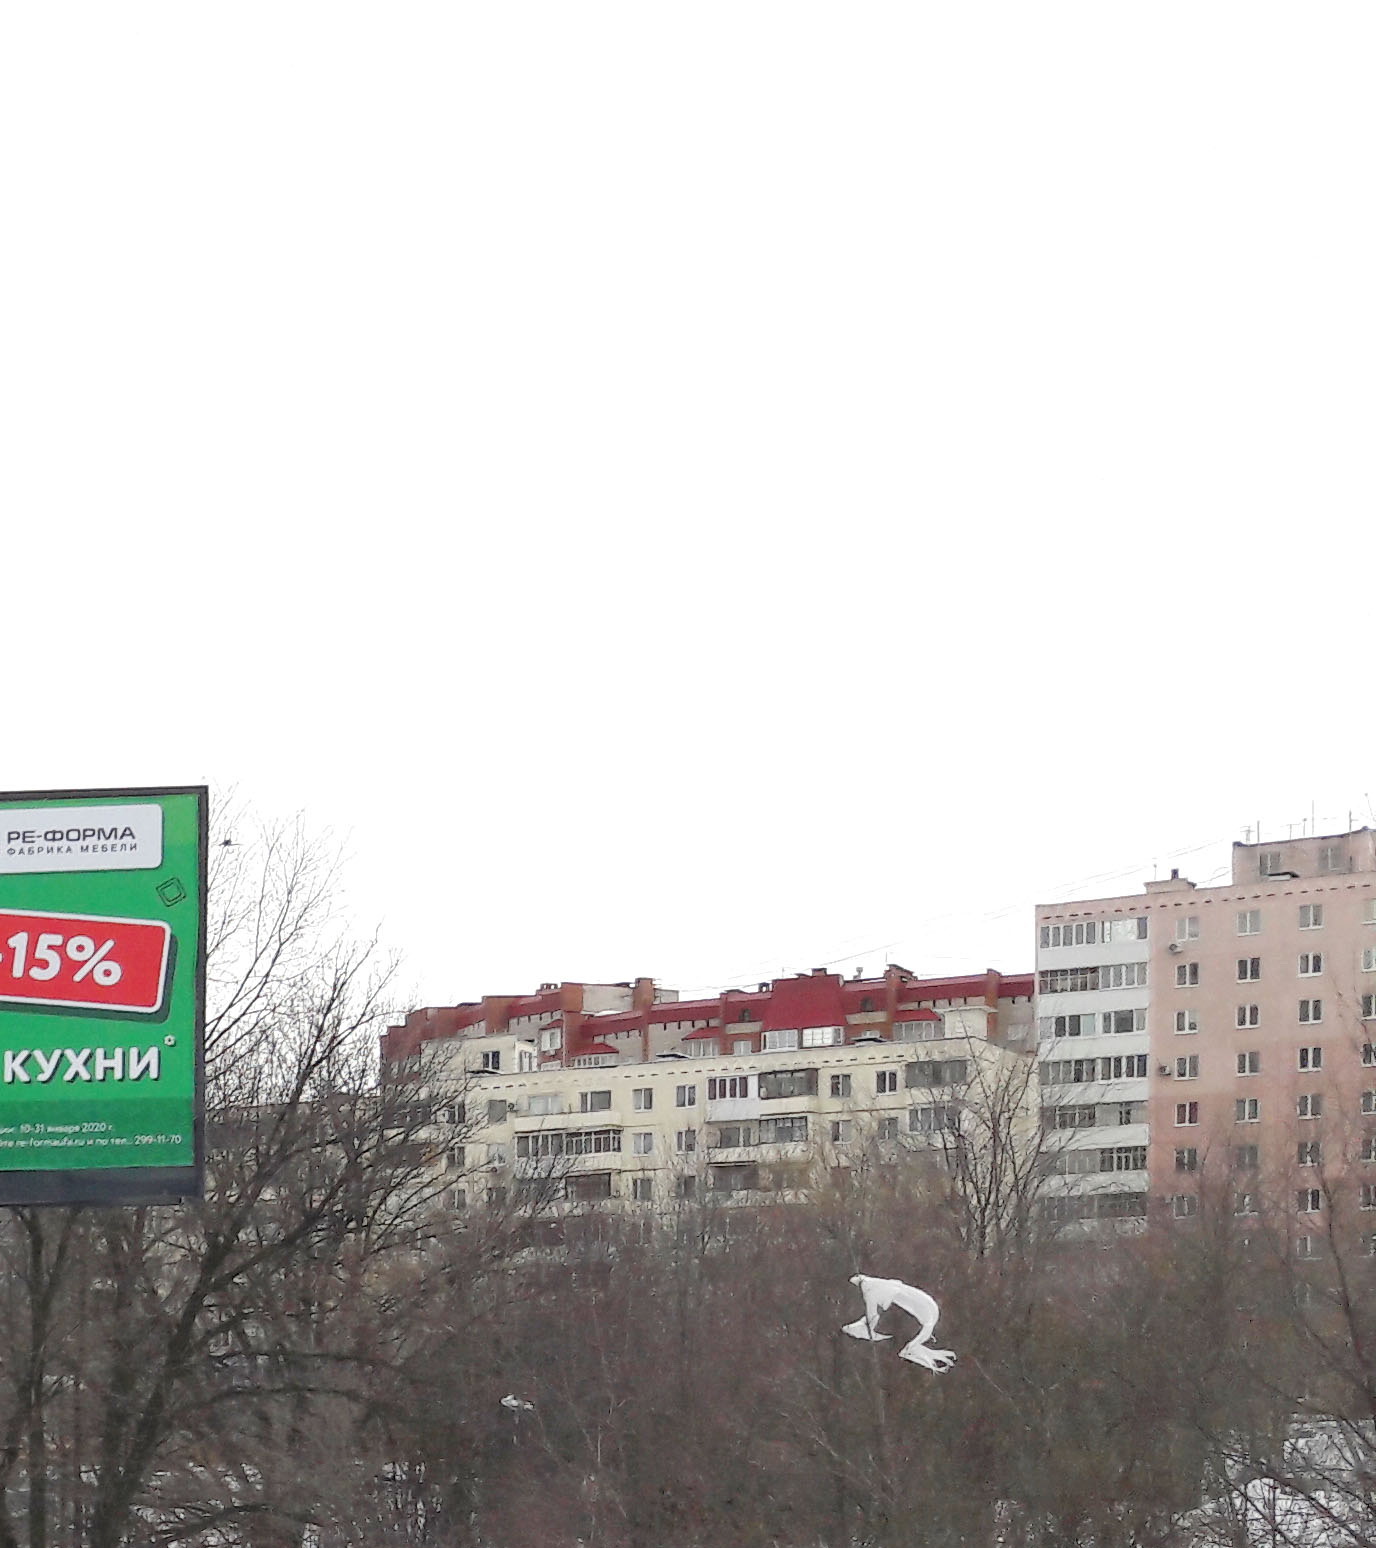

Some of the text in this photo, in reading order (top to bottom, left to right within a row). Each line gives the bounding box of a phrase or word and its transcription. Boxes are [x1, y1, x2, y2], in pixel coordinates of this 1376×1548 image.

[6, 826, 136, 845] РЕ-ФОРМА
[6, 842, 137, 856] ФАБРИКА МЕБЕЛИ
[81, 1122, 107, 1133] 2020
[134, 1134, 182, 1146] 299-11-70
